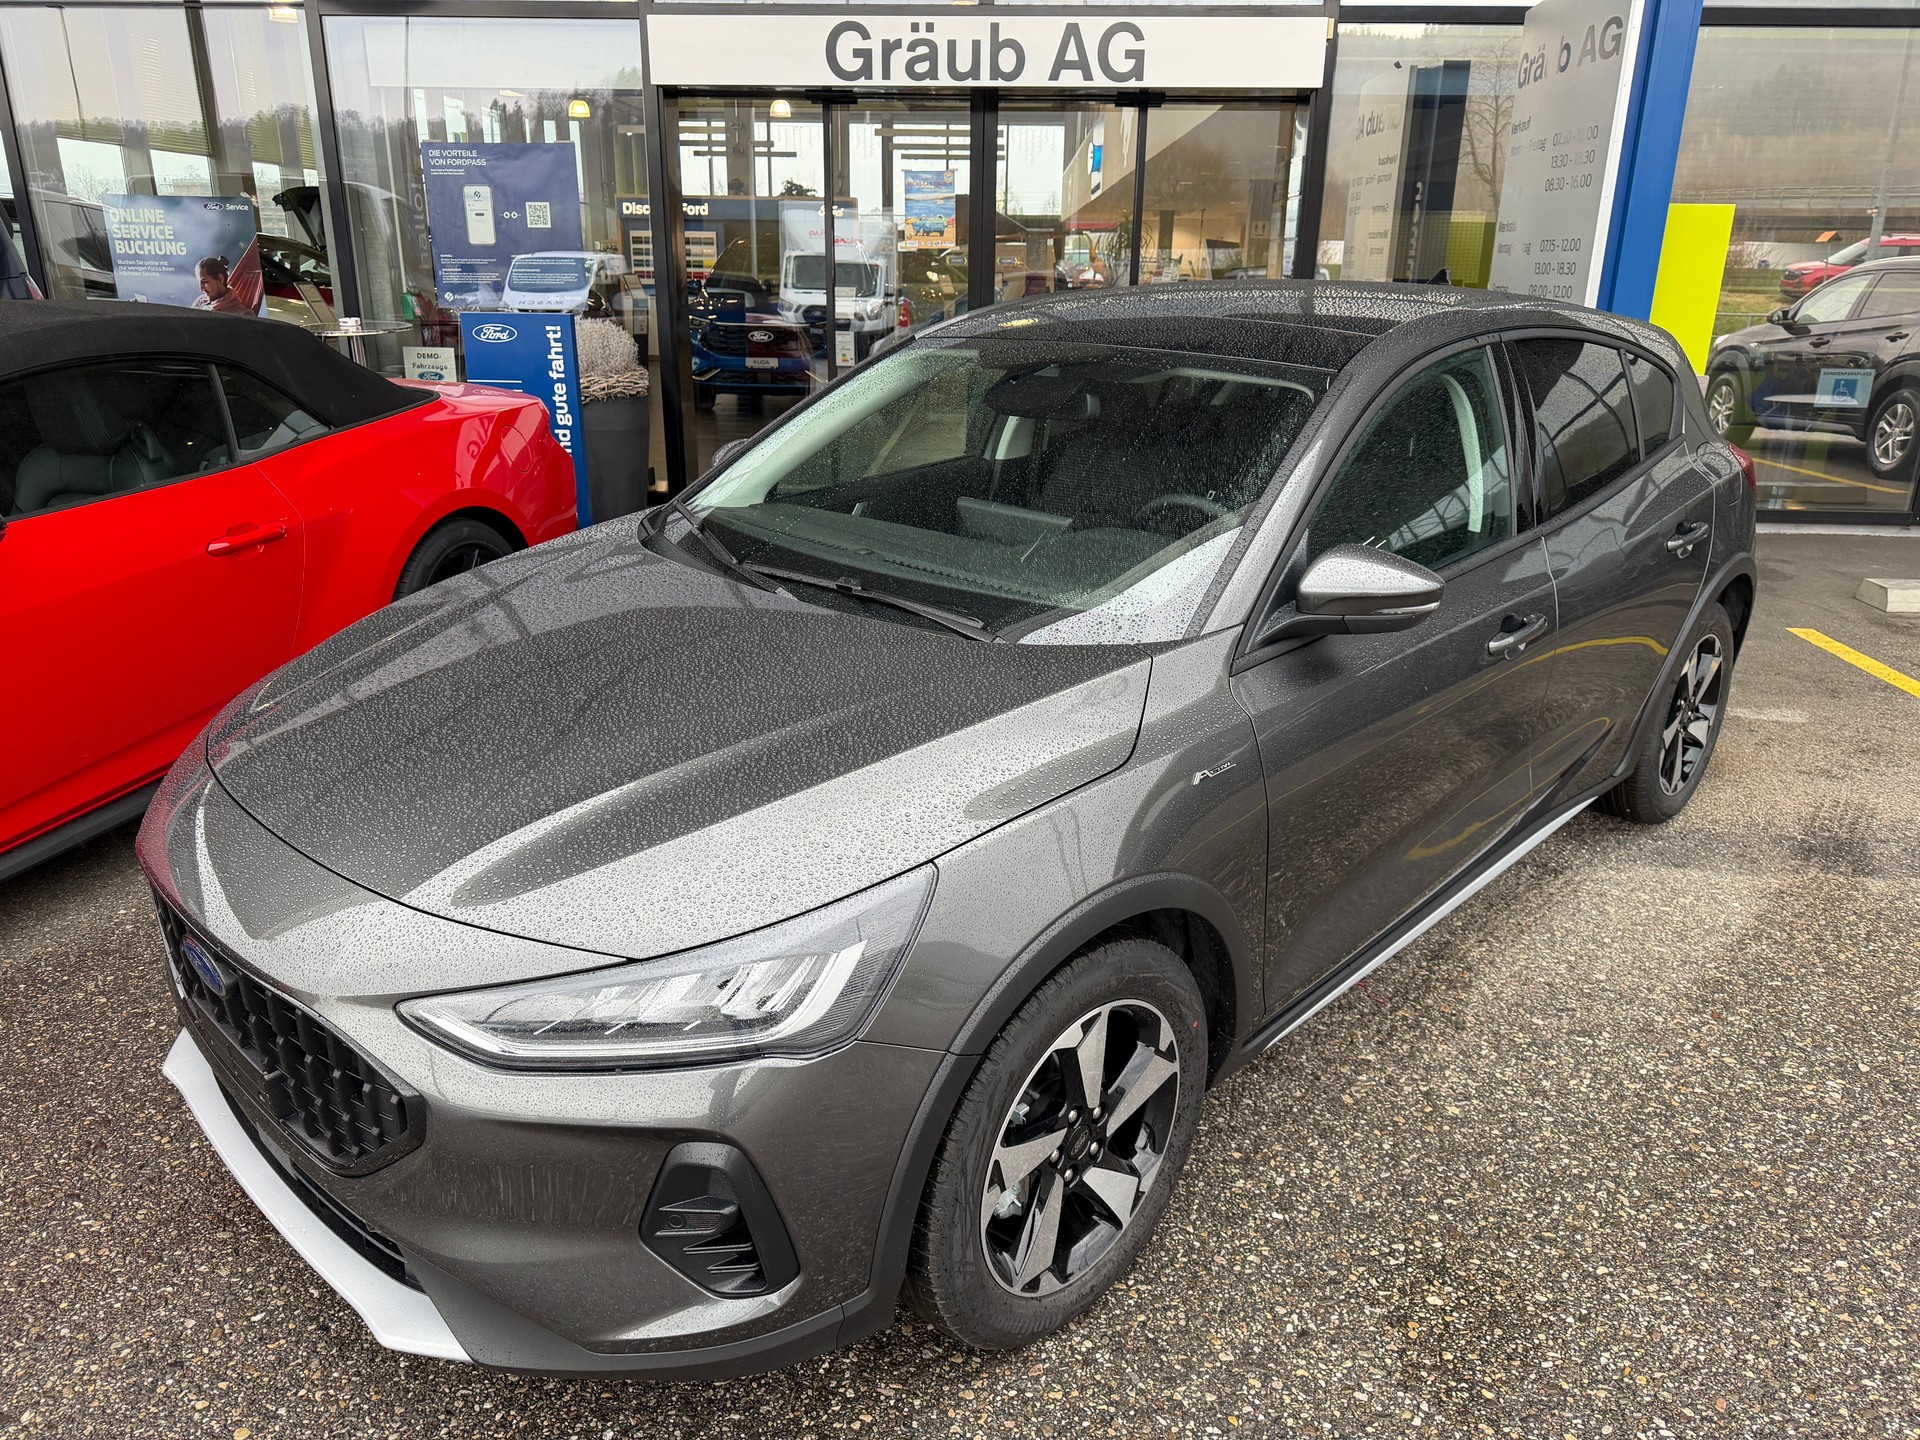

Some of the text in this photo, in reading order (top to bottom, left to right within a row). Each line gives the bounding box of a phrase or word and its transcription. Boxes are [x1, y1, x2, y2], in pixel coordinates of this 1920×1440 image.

[825, 20, 1146, 83] Gräub AG
[1518, 16, 1623, 89] Gräb AG
[441, 149, 478, 157] VORTEILE
[429, 158, 487, 166] VON FORDPASS
[226, 203, 249, 211] Service
[622, 202, 651, 215] Disc
[110, 208, 165, 224] ONLINE
[112, 223, 175, 239] SERVICE
[115, 240, 187, 256] BUCHUNG
[1561, 238, 1581, 253] 12.00
[1534, 262, 1551, 275] 13.00
[1557, 262, 1577, 275] 18.30
[1553, 285, 1573, 298] 12.00
[478, 325, 512, 341] Ford
[751, 332, 771, 341] Ford
[412, 363, 448, 371] Fahrzeuge
[420, 372, 441, 380] Ford
[545, 325, 573, 457] nd gute fahrt!
